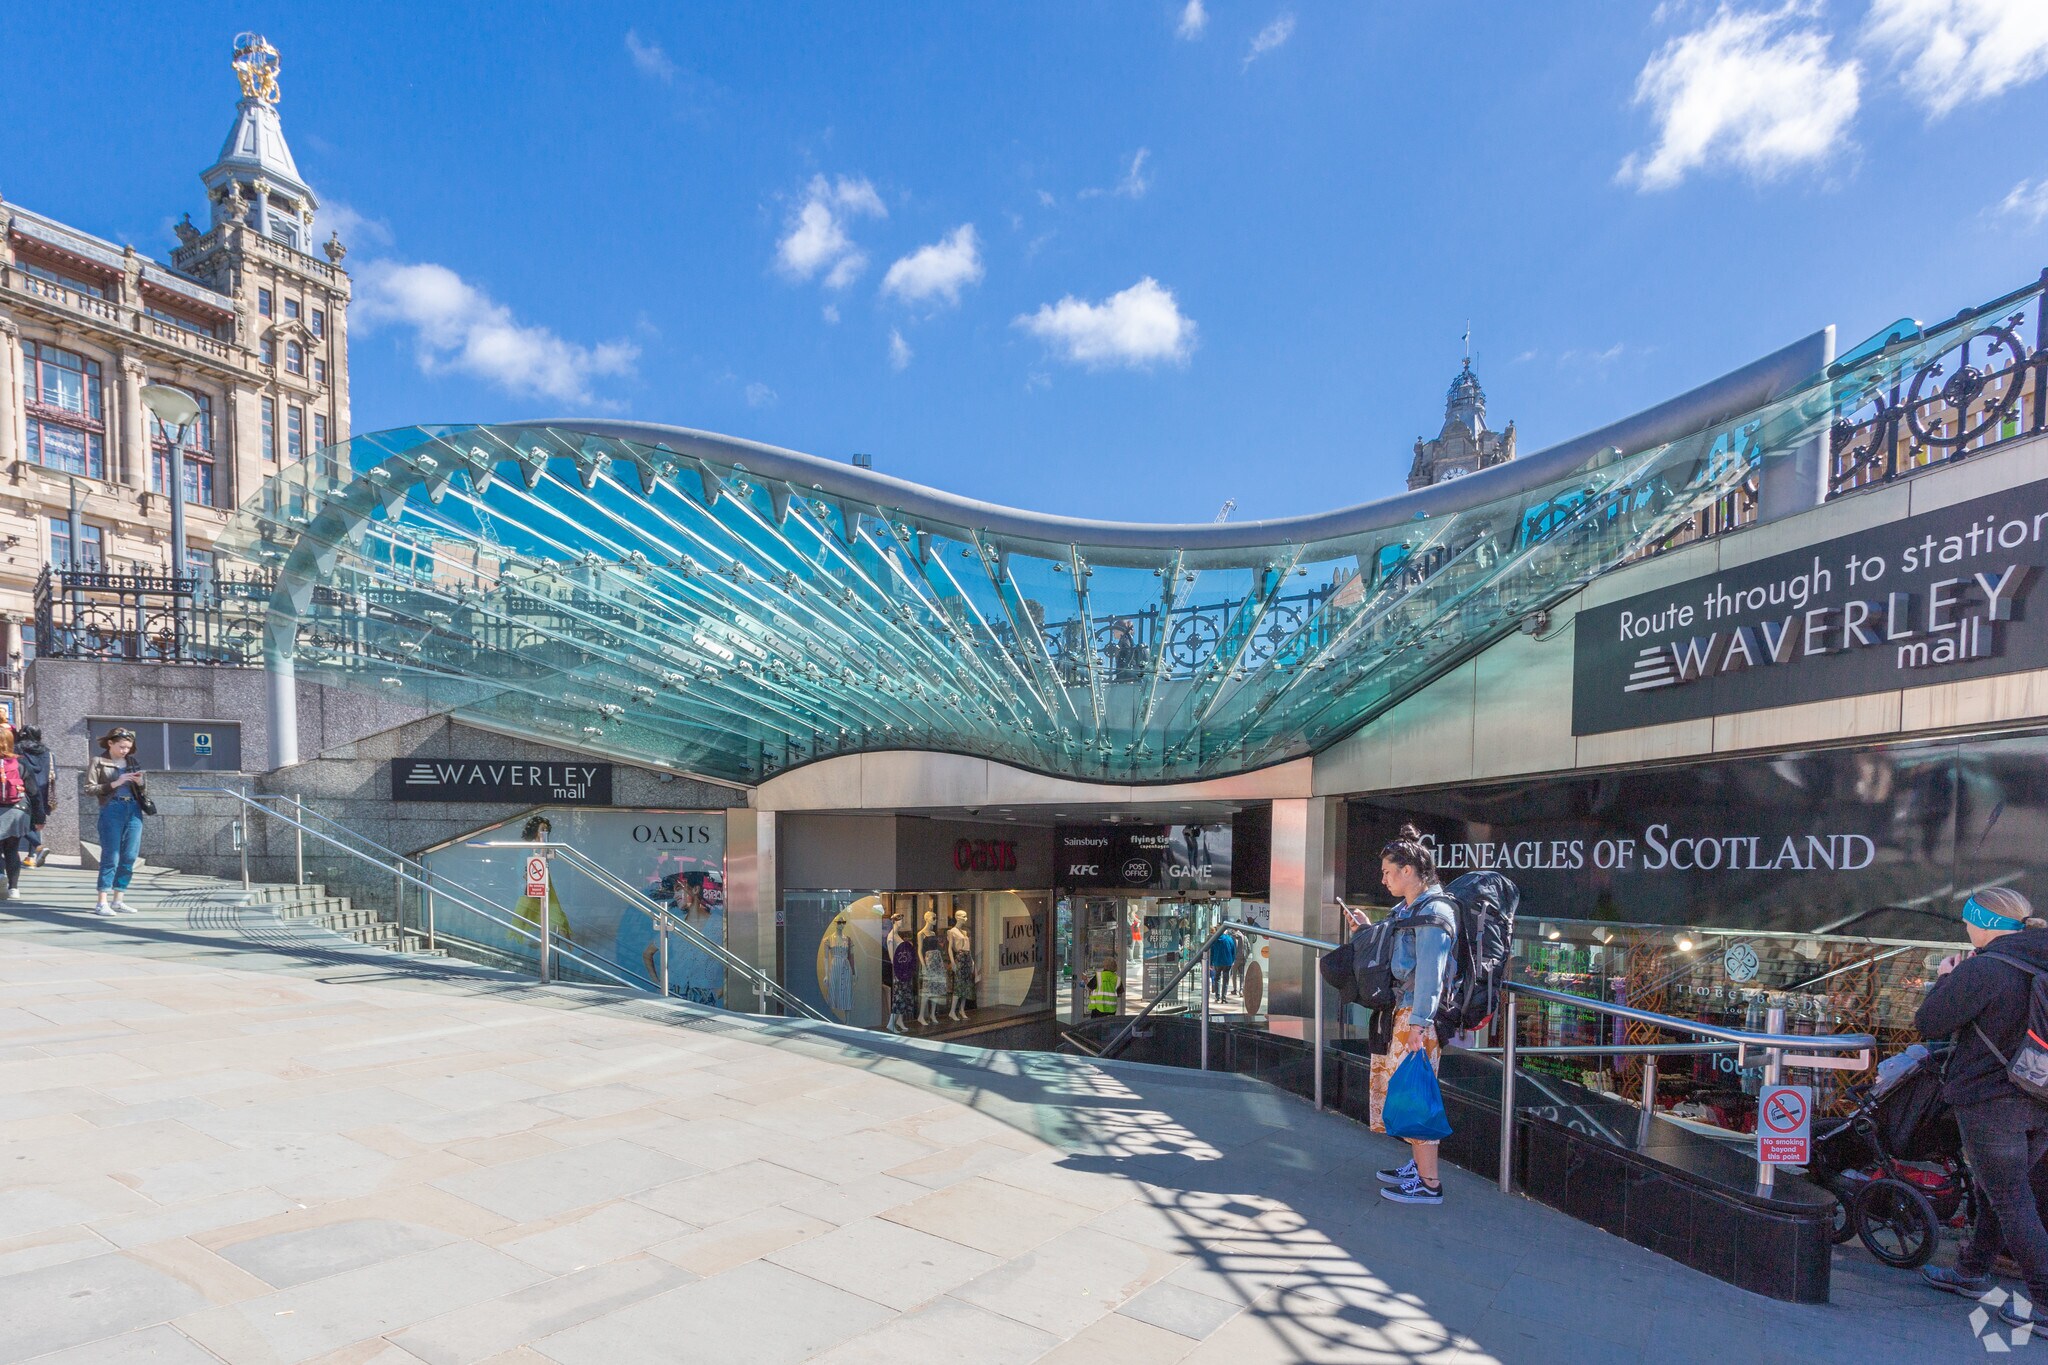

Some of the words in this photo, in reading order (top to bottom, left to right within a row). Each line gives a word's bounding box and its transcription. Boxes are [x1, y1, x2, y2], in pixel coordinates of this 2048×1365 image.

[1620, 603, 1694, 641] Route
[1703, 556, 1832, 620] through
[1845, 554, 1886, 586] to
[1670, 564, 2018, 680] WAVERLEY
[1897, 615, 1980, 669] mall
[436, 763, 598, 787] WAVERLEY
[553, 783, 586, 800] mall
[632, 824, 710, 844] OASIS
[1063, 837, 1109, 847] Sainsbury's
[1130, 835, 1156, 845] flying
[1593, 839, 1636, 870] OF
[1643, 823, 1876, 871] SCOTLAND
[1068, 864, 1100, 876] KFC
[1124, 869, 1149, 877] OFFICE
[1169, 864, 1212, 878] GAME
[1006, 919, 1041, 942] Lovely
[1001, 947, 1029, 966] does
[1775, 1138, 1804, 1147] smoking
[1782, 1153, 1800, 1161] point
